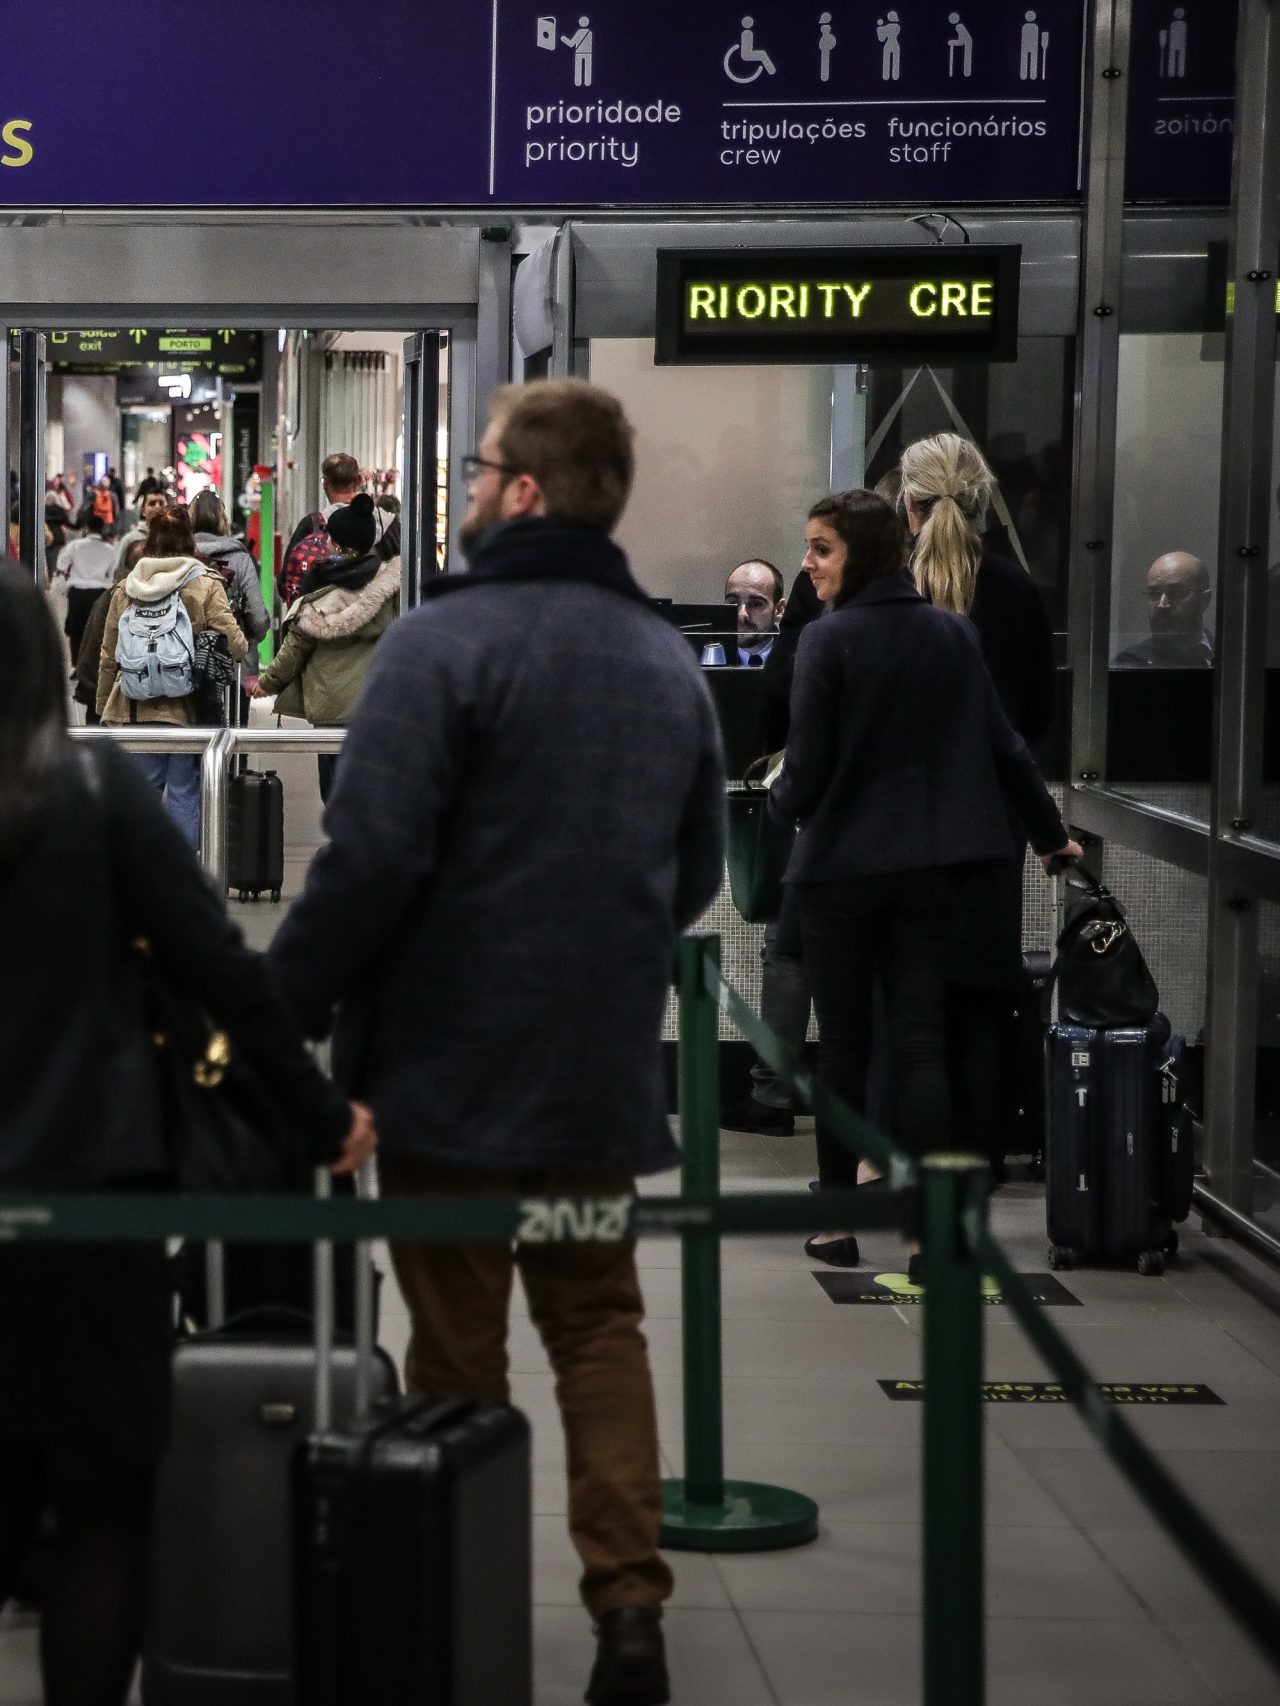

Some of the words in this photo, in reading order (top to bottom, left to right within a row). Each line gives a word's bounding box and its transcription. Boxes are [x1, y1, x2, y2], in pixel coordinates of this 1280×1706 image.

[525, 99, 682, 127] prioridade
[720, 118, 867, 142] tripulações
[887, 115, 1048, 138] funcionários
[525, 135, 640, 168] priority
[720, 149, 782, 165] crew
[889, 141, 952, 163] staff
[79, 340, 103, 352] exit
